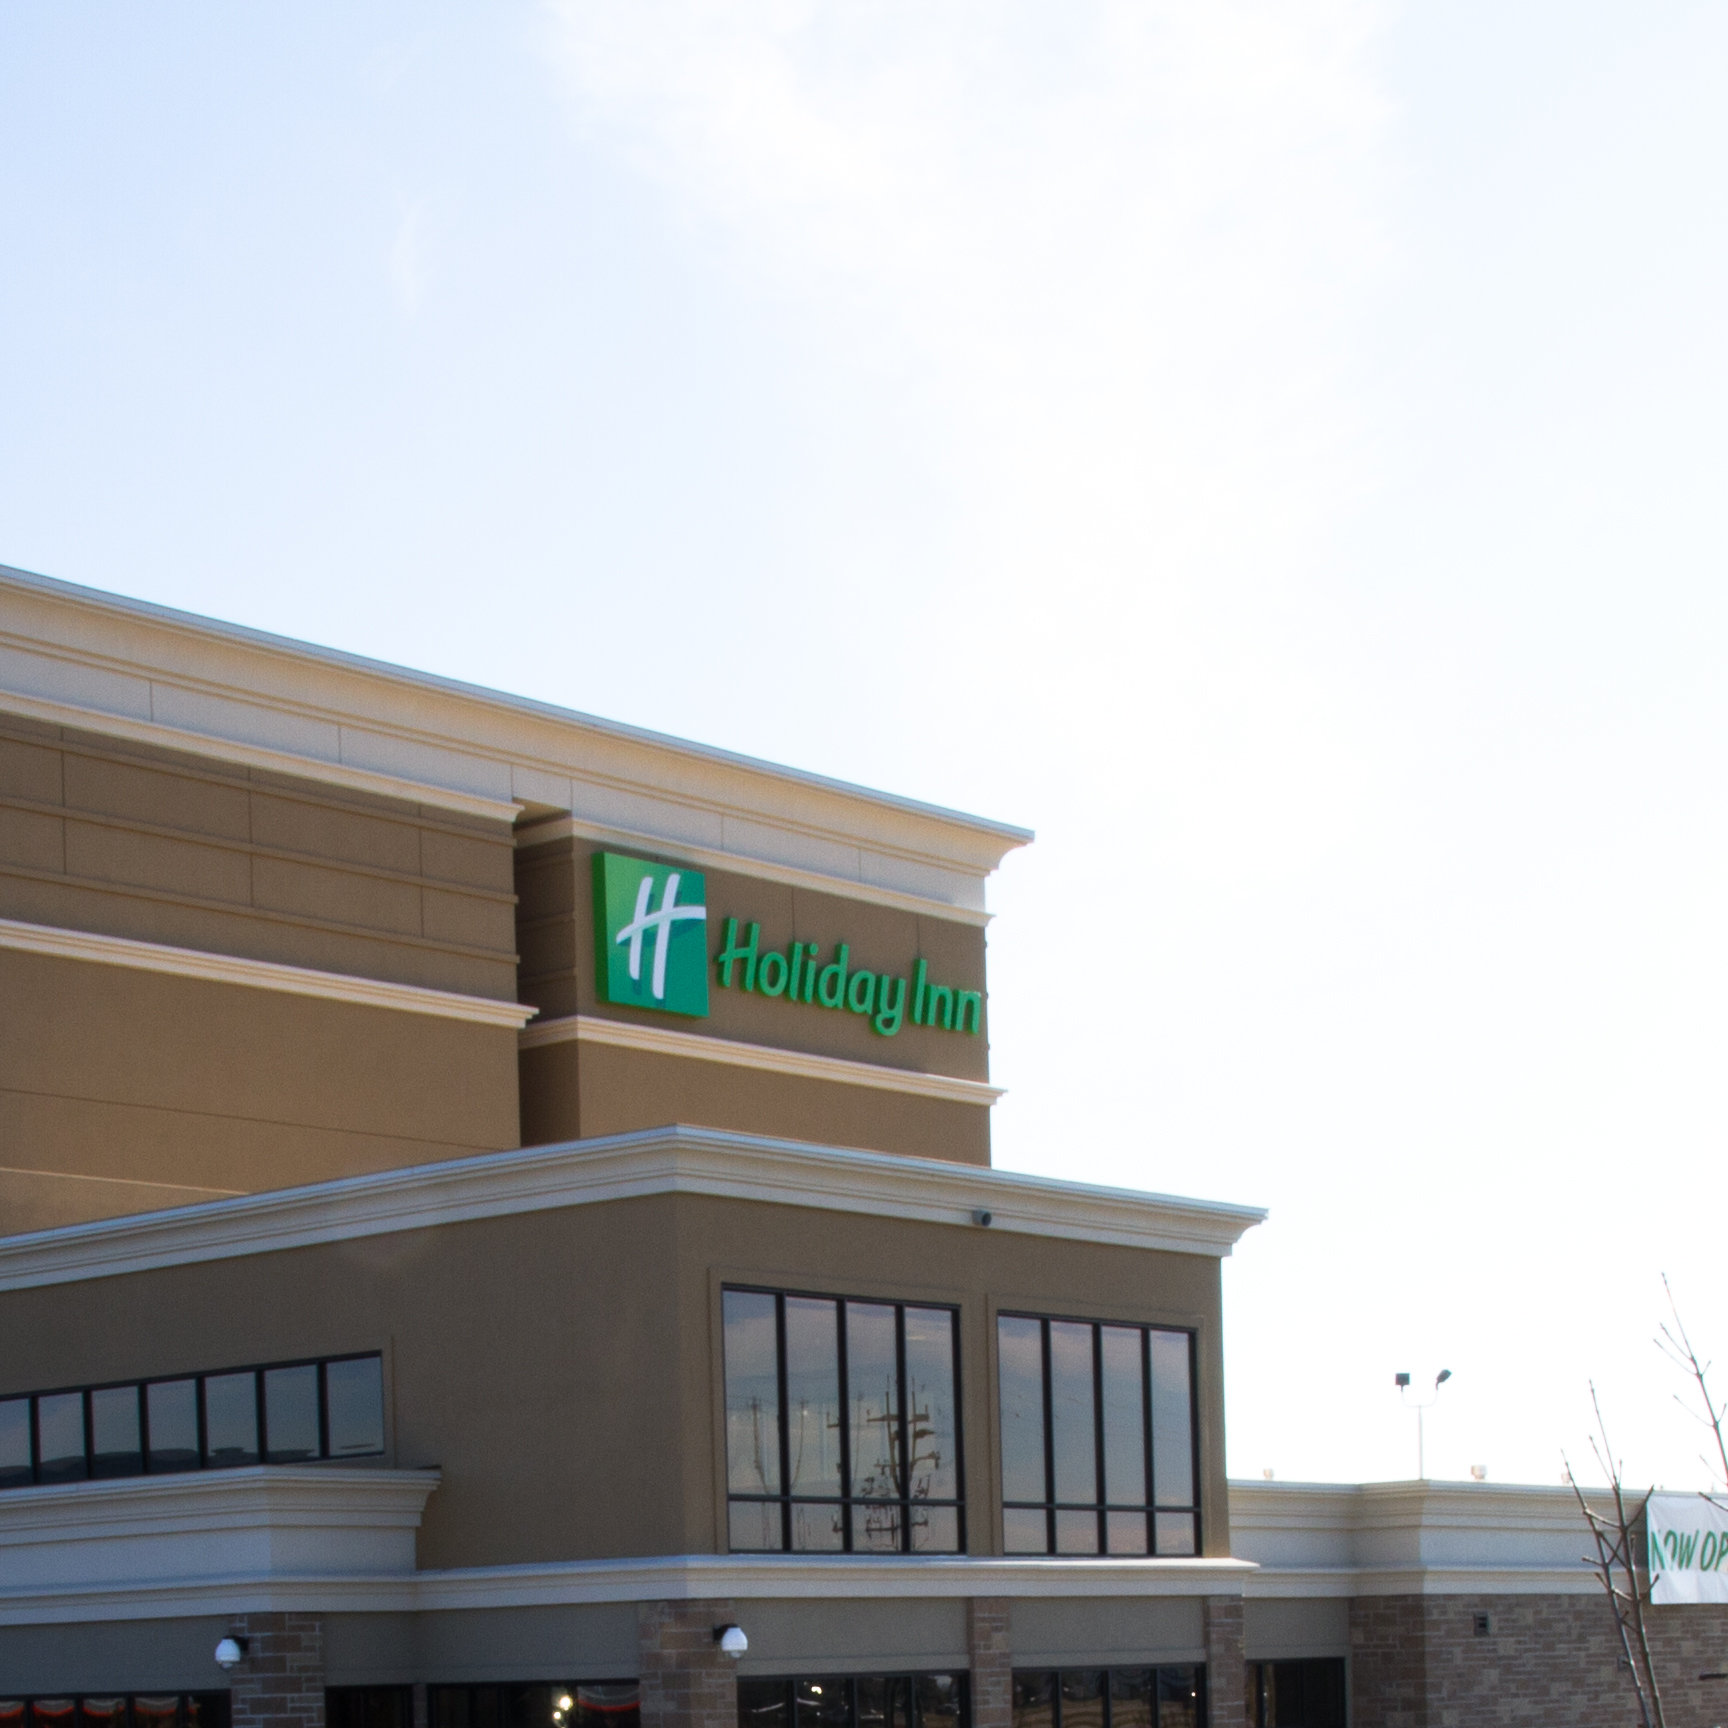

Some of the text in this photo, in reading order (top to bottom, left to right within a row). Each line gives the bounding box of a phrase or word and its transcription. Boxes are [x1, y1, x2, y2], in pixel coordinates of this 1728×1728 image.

[717, 917, 982, 1037] Holiday Inn
[1650, 1529, 1700, 1572] NOW
